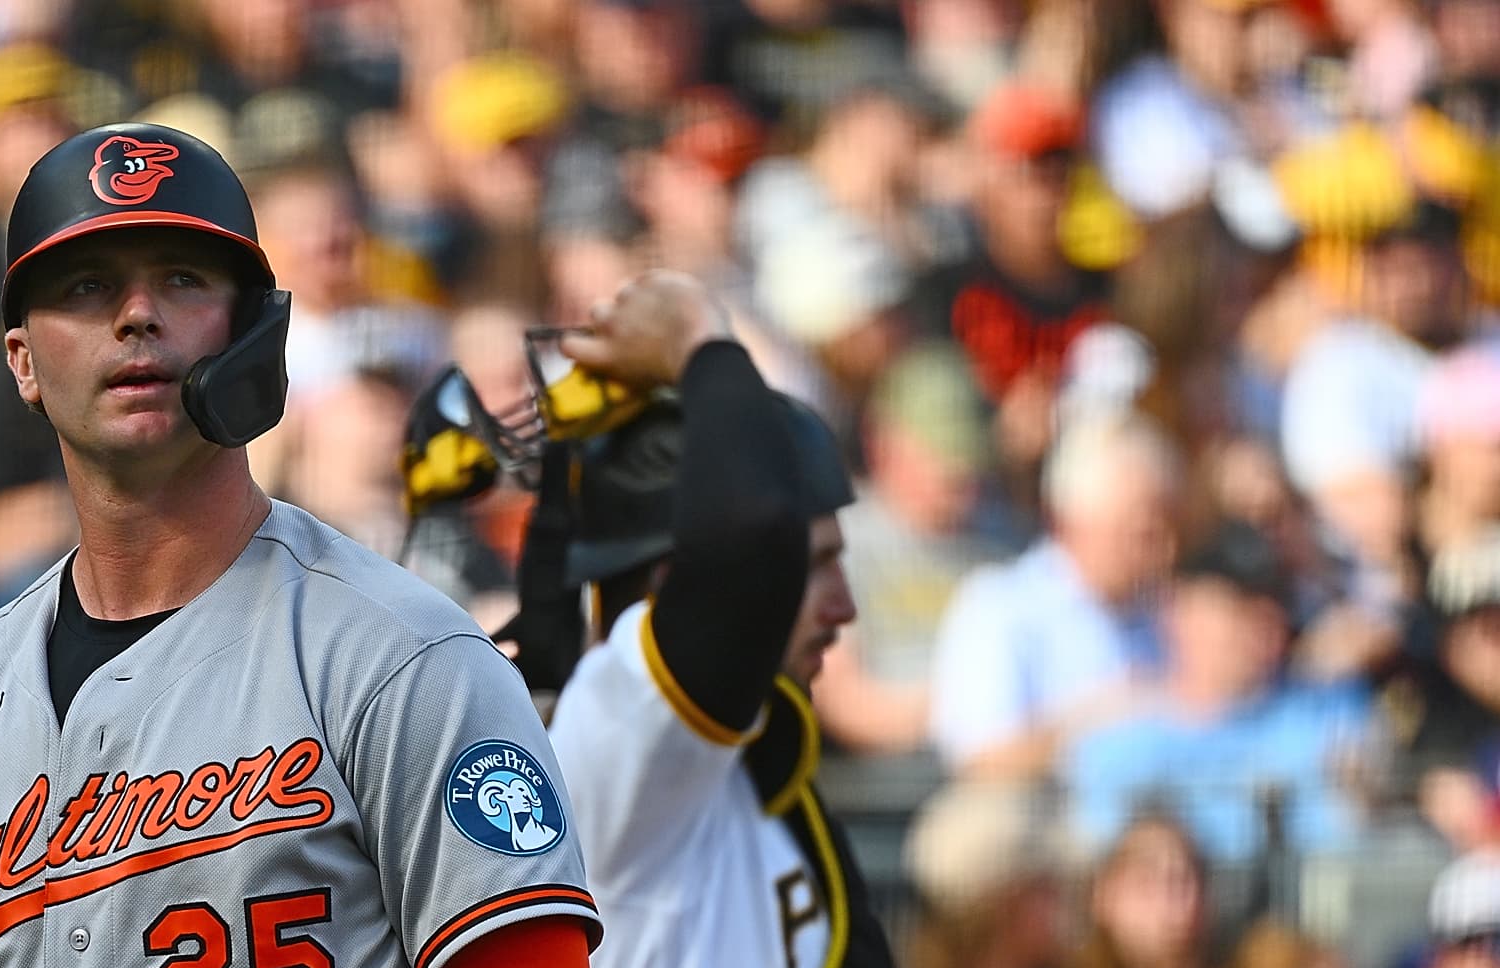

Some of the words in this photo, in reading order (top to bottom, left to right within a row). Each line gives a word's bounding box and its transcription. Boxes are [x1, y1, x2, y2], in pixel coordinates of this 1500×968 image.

[456, 752, 503, 788] Rowe
[502, 749, 543, 787] Price
[452, 787, 473, 804] T.
